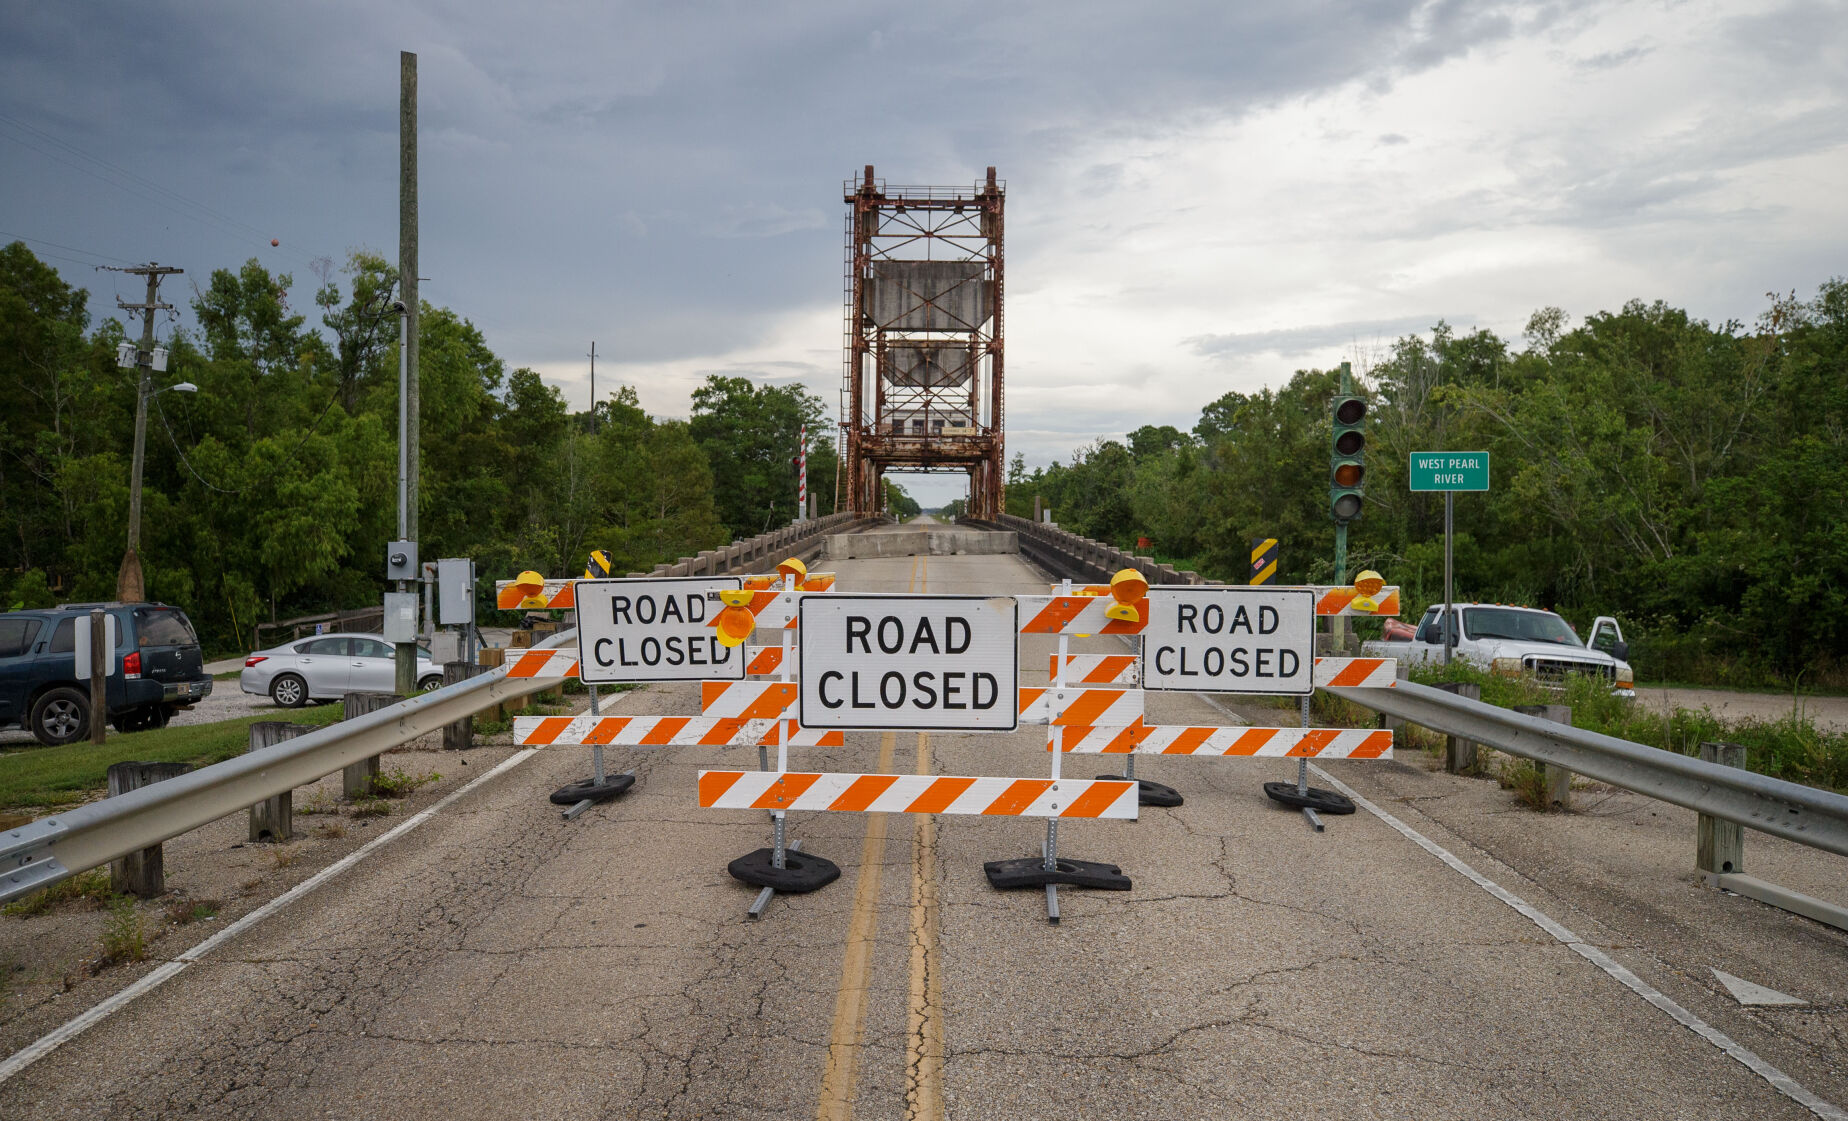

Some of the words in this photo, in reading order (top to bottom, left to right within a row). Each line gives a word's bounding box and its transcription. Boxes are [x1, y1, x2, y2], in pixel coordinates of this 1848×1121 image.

[1419, 459, 1445, 469] WEST
[1449, 459, 1480, 469] PEARL
[1434, 474, 1464, 484] RIVER
[611, 594, 705, 625] ROAD
[1177, 603, 1280, 635] ROAD
[846, 615, 972, 655] ROAD
[594, 636, 731, 667] CLOSED
[1155, 645, 1300, 678] CLOSED
[818, 670, 999, 710] CLOSED
